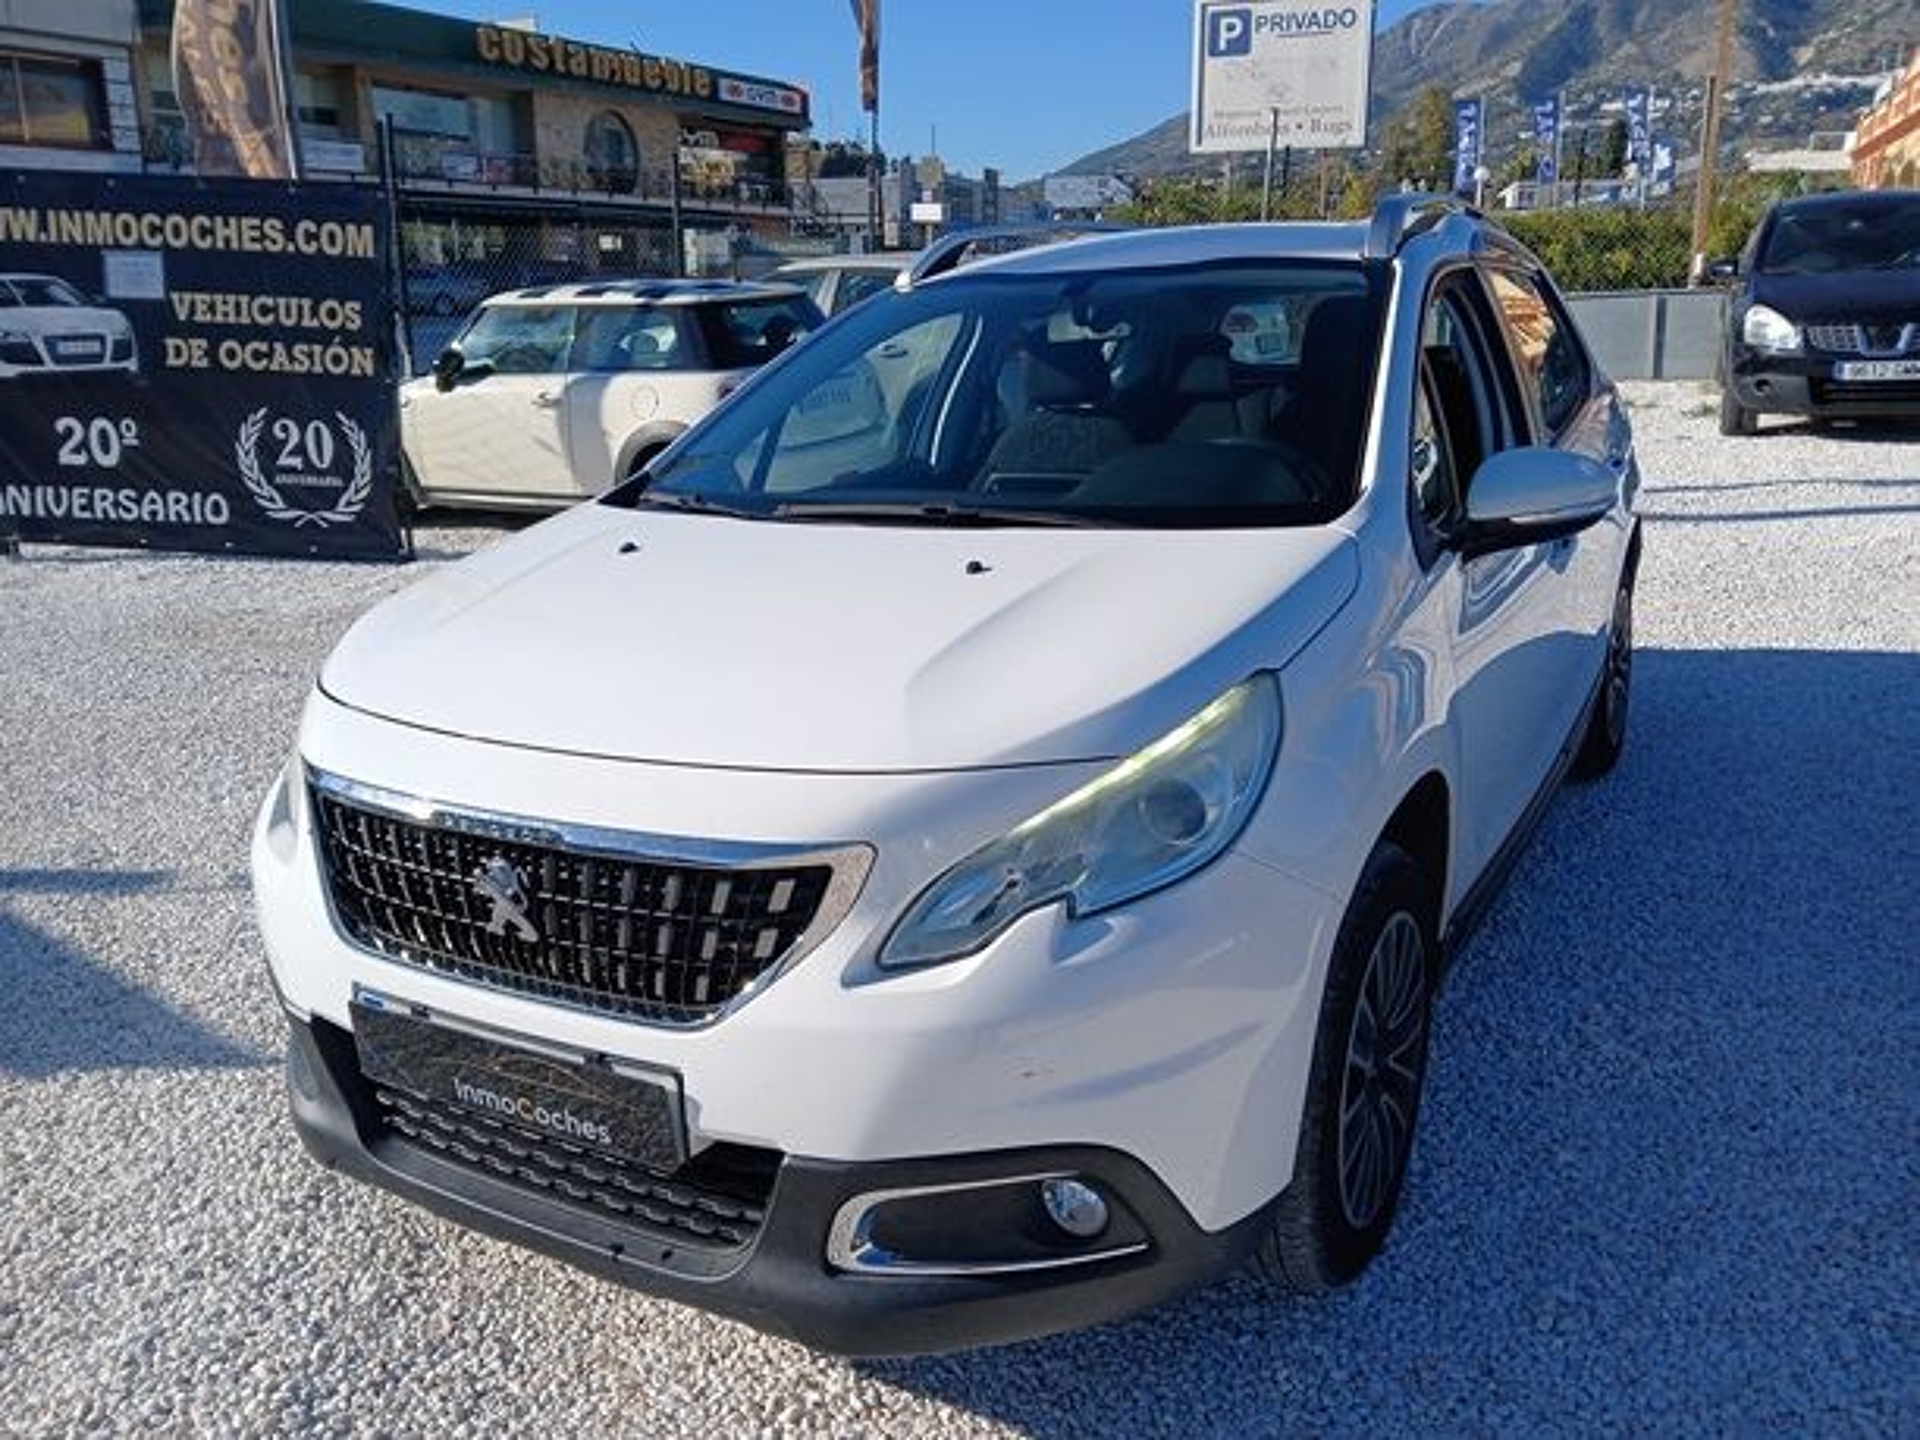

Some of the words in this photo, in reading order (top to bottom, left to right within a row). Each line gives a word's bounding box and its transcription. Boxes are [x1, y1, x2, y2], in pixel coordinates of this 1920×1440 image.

[1219, 17, 1243, 50] P
[1254, 8, 1357, 34] PRIVADO
[169, 291, 363, 331] VEHICULOS
[164, 338, 209, 368] DE
[218, 336, 375, 376] OCASIÓN
[272, 418, 334, 471] 20
[0, 485, 230, 524] NIVERSARIO
[453, 1078, 613, 1145] InmoCoches
